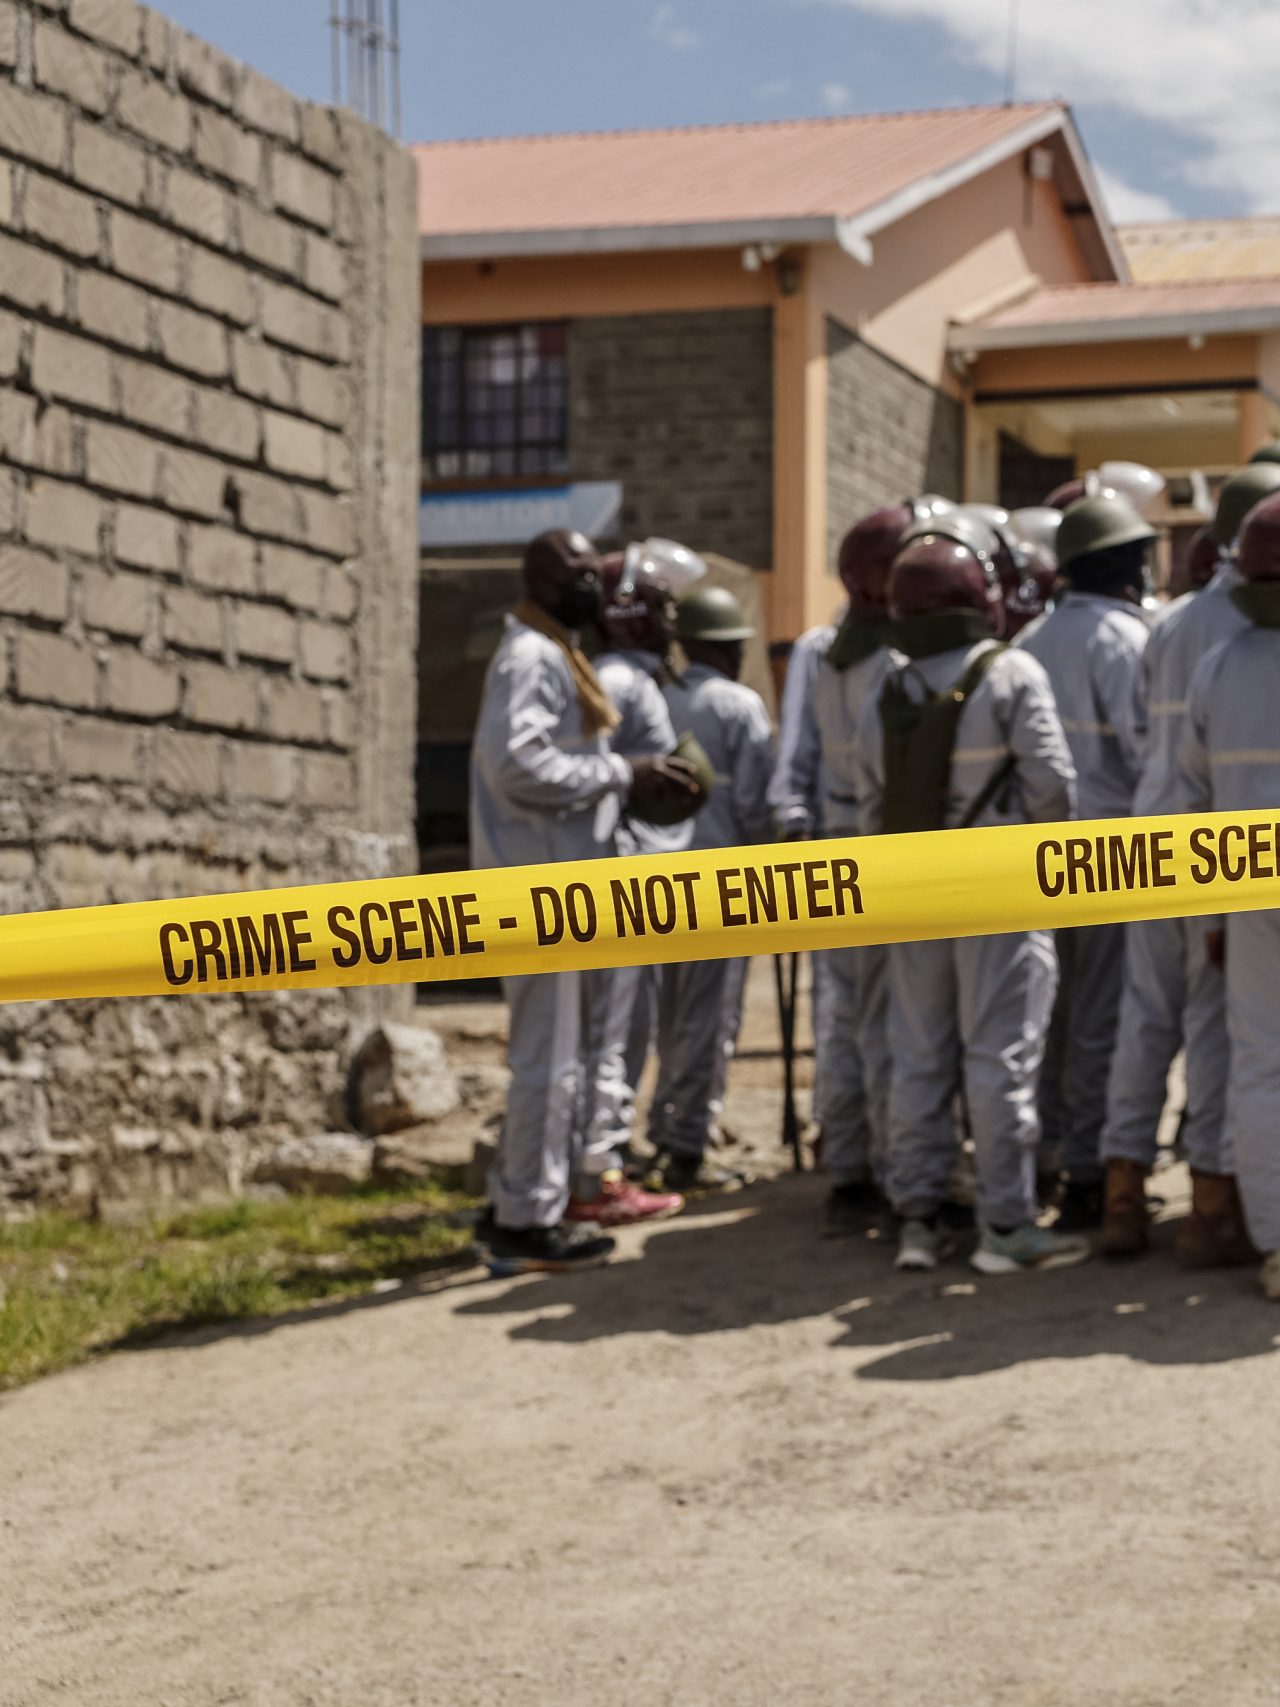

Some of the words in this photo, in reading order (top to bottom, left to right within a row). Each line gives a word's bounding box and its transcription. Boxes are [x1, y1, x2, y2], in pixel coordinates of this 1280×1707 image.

[1035, 830, 1177, 898] CRIME
[159, 910, 317, 986] CRIME
[327, 893, 486, 969] SCENE
[529, 882, 597, 947] DO
[609, 871, 701, 939] NOT
[715, 858, 865, 927] ENTER
